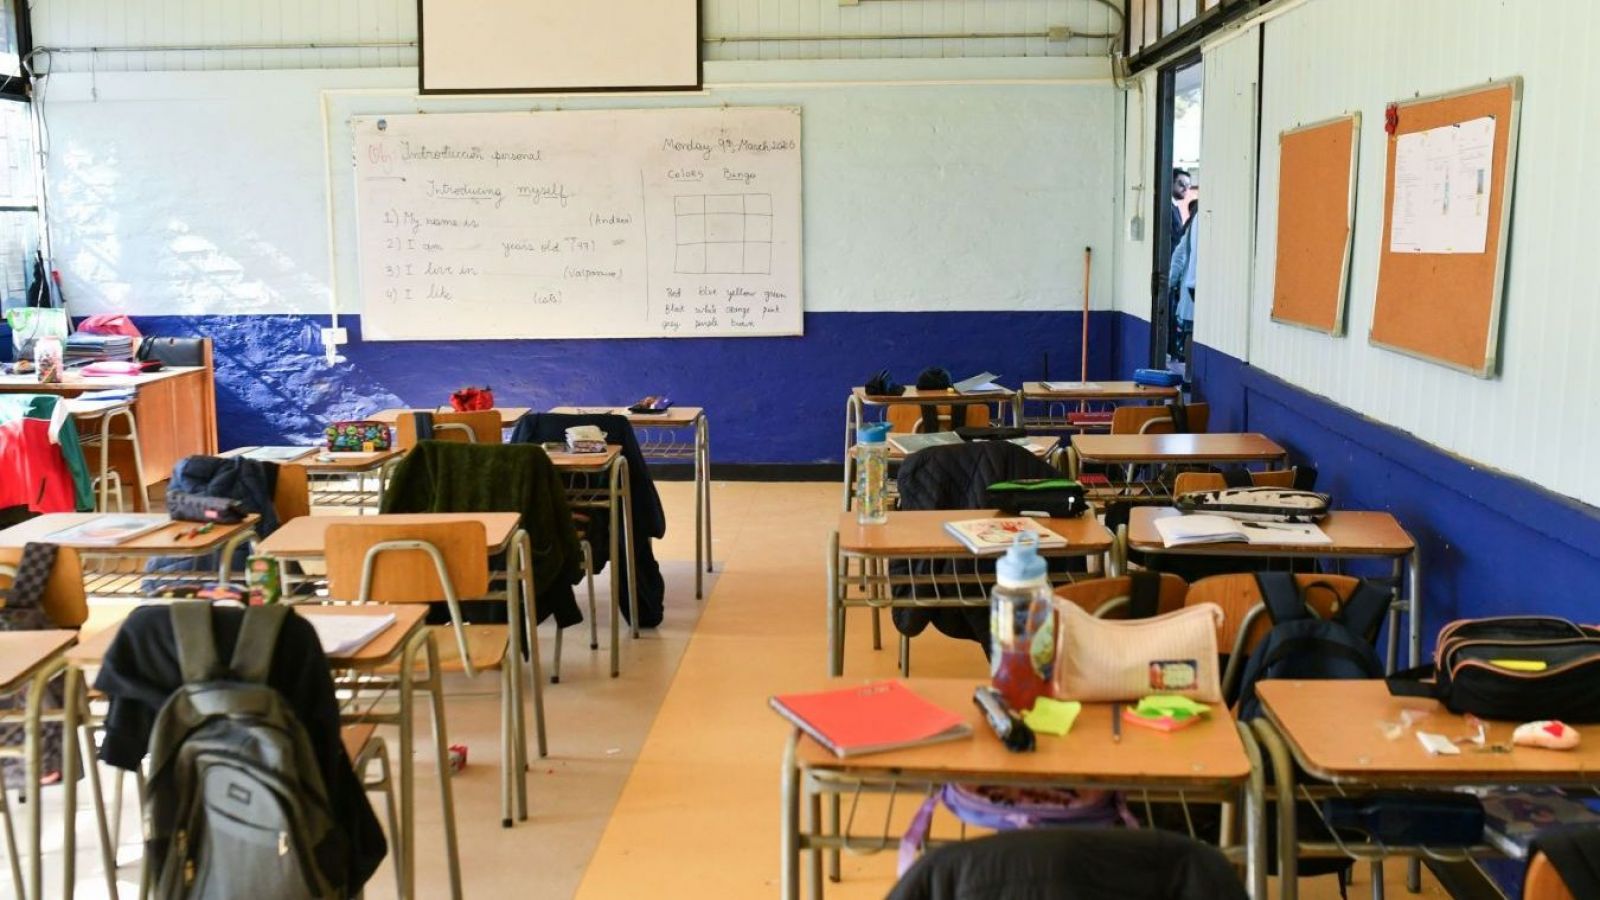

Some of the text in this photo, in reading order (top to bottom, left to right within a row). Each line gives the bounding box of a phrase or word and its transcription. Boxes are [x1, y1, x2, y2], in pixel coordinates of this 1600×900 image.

[426, 180, 502, 209] Introducing
[425, 217, 458, 226] name
[464, 216, 480, 228] is
[408, 239, 415, 250] I
[422, 241, 443, 251] am
[501, 239, 534, 257] years
[404, 264, 416, 275] I
[404, 288, 414, 300] I
[726, 287, 756, 302] yellow
